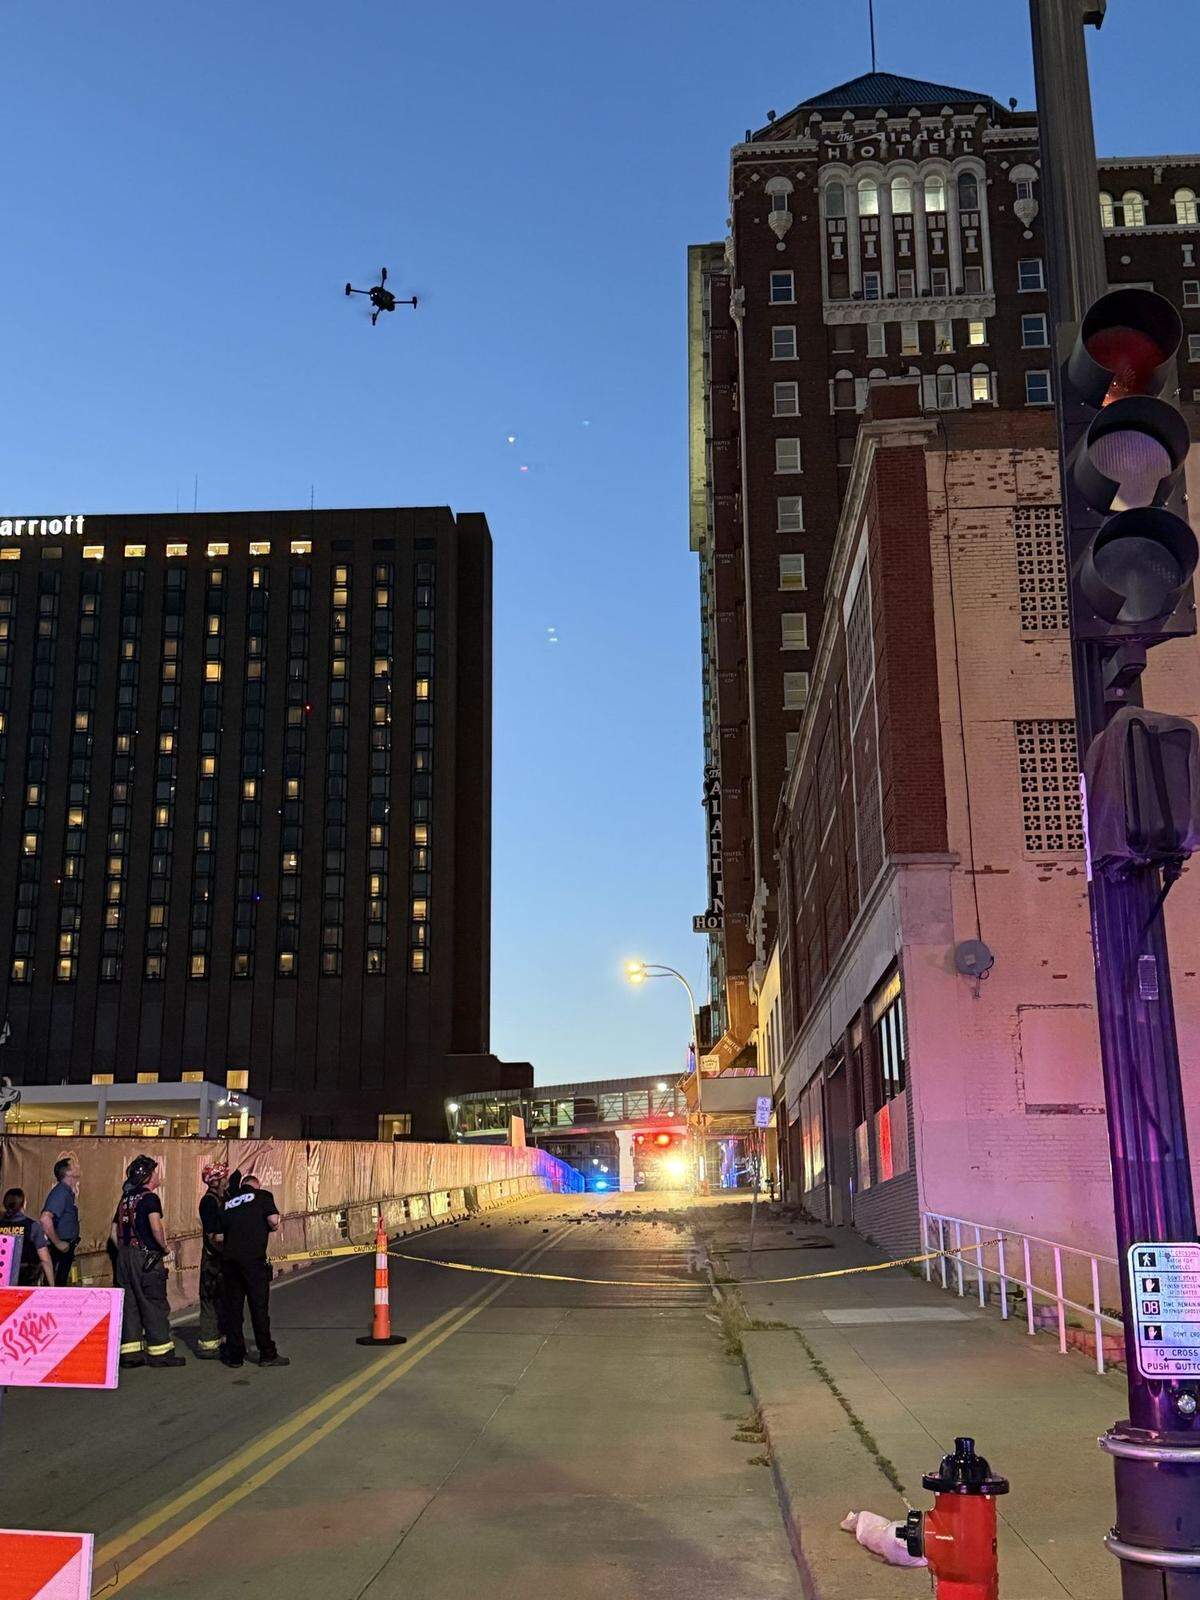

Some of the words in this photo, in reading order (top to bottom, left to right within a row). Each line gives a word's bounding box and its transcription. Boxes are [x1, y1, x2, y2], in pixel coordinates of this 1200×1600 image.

[837, 132, 854, 142] The
[827, 141, 975, 160] HOTEL
[309, 1250, 333, 1258] CAUTION
[1143, 1302, 1159, 1314] 08
[1154, 1349, 1165, 1357] TO
[1171, 1349, 1199, 1357] CROSS
[1147, 1362, 1170, 1371] PUSH
